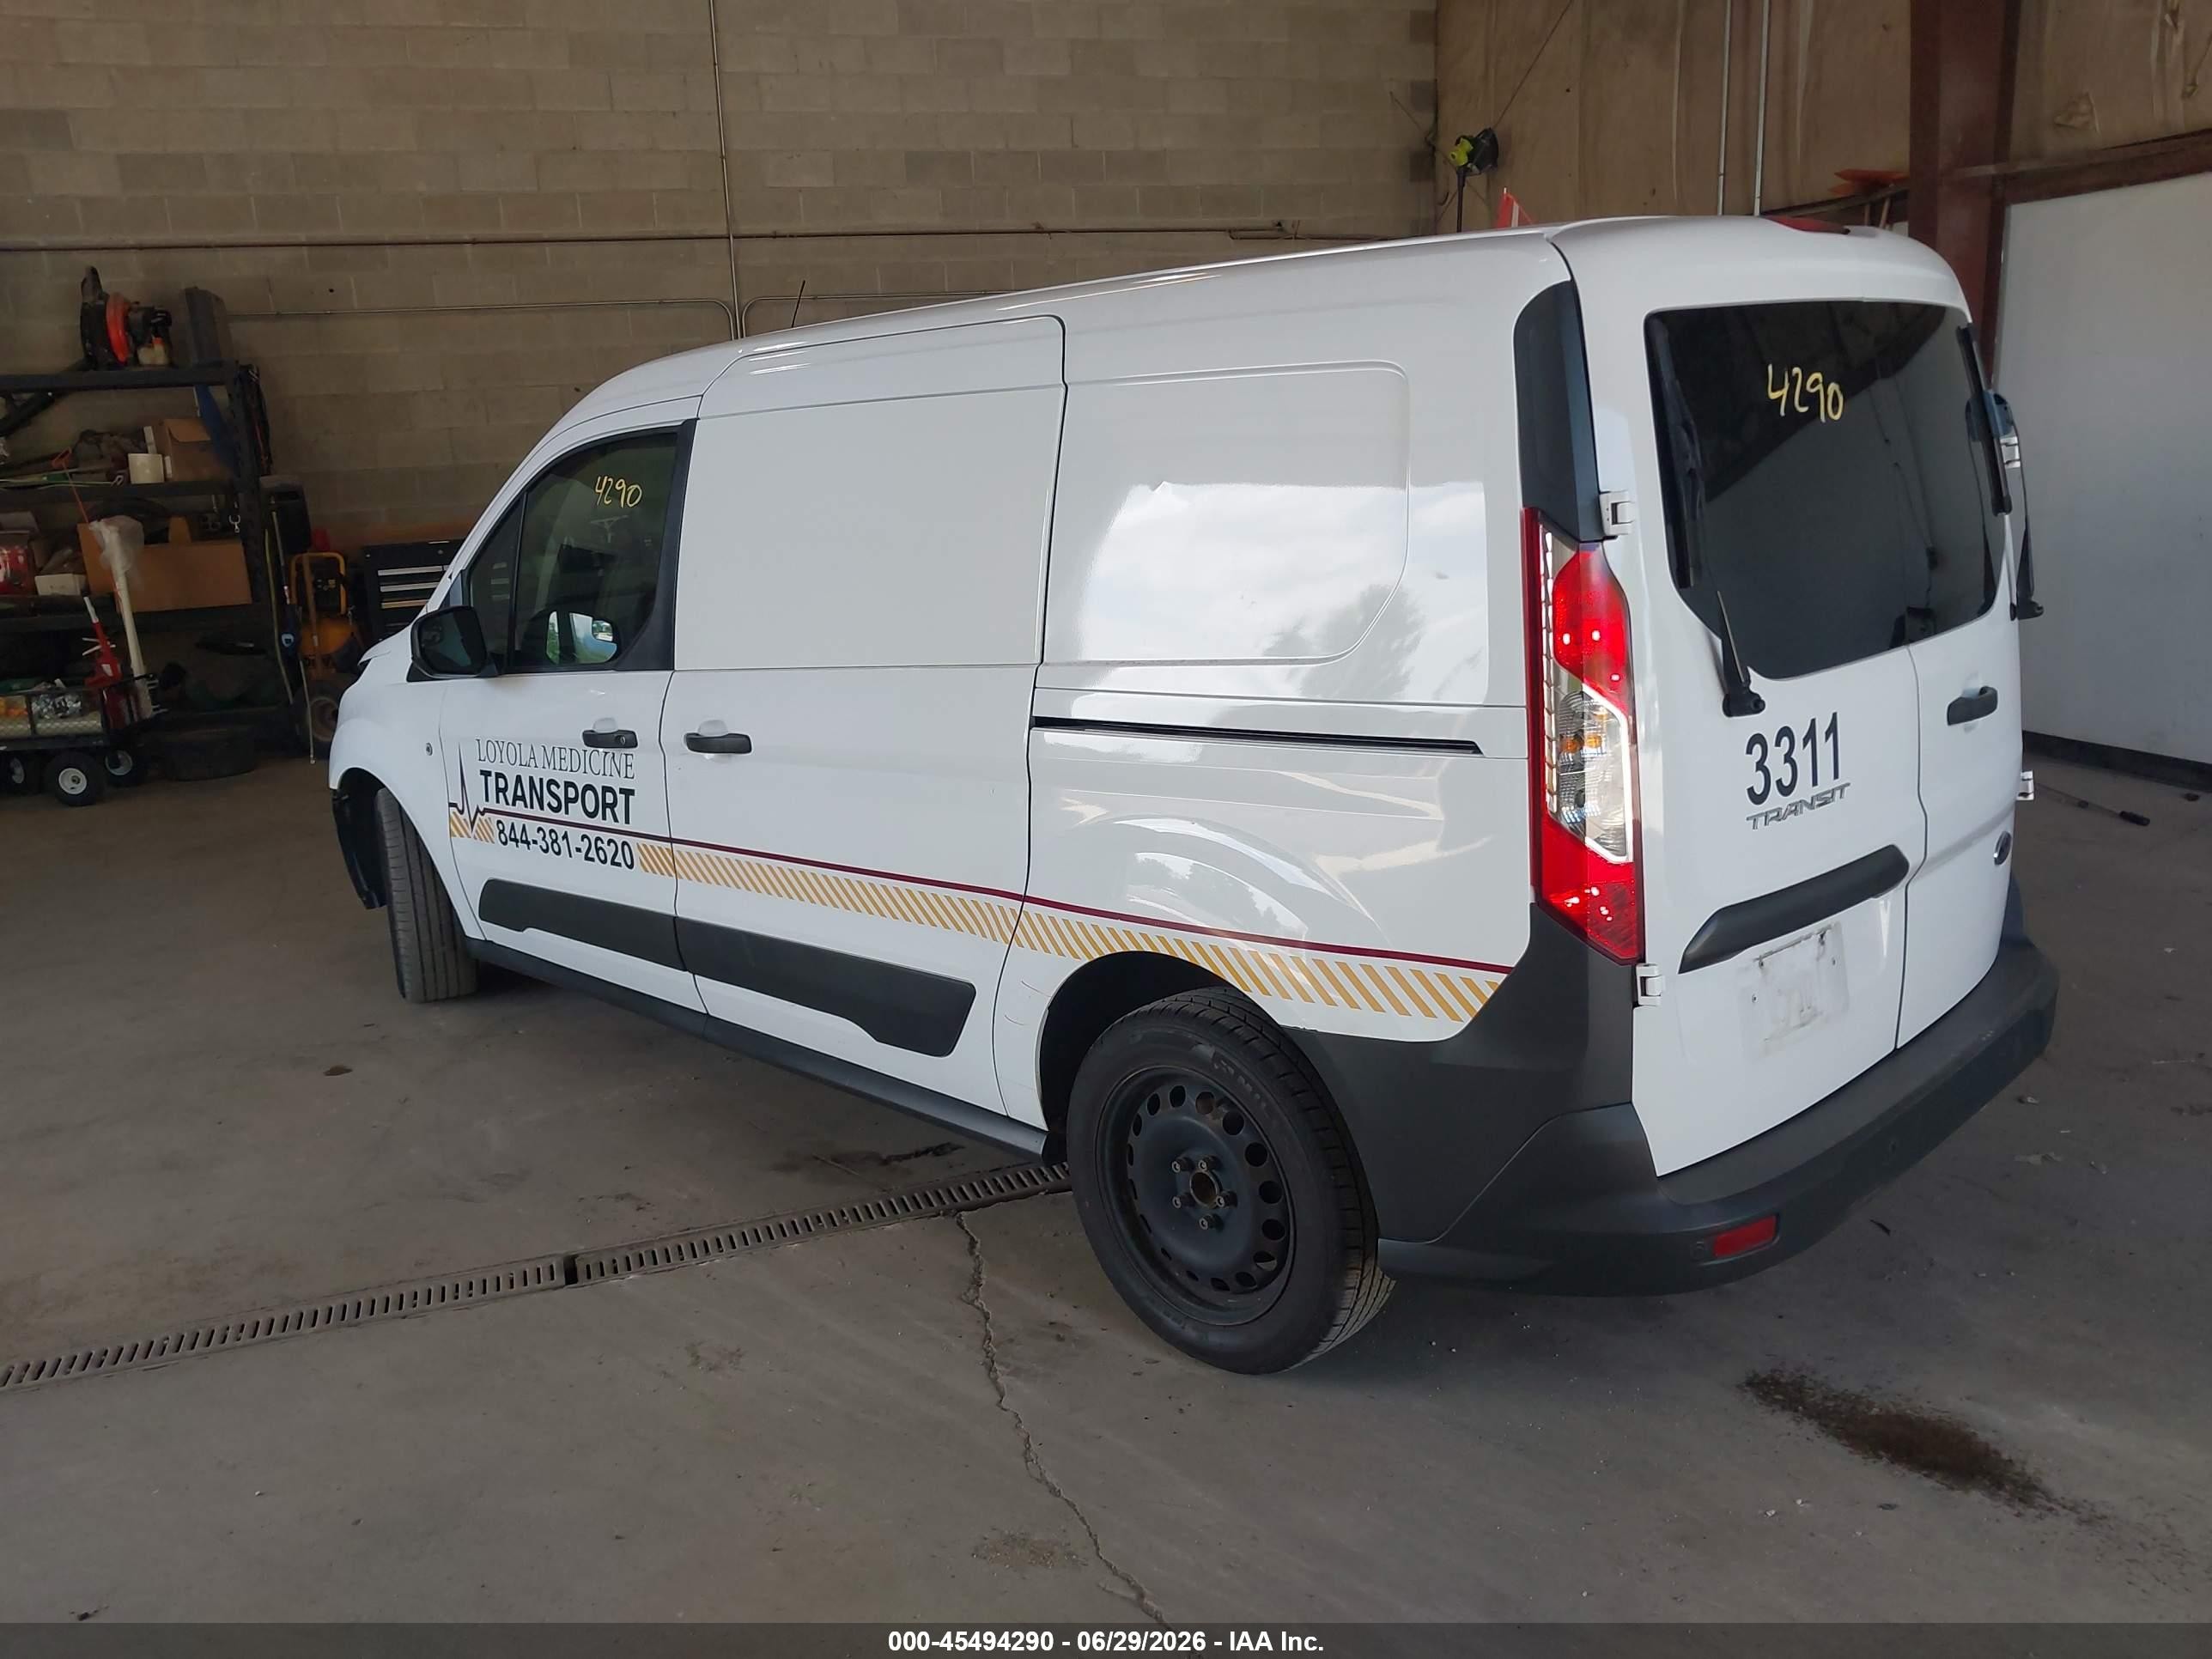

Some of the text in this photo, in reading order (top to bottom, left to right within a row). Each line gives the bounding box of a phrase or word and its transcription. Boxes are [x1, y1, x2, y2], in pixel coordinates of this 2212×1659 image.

[1767, 363, 1844, 422] 4290
[595, 476, 642, 508] 4290
[476, 738, 635, 780] LOYOLA MEDICINE
[1746, 712, 1839, 805] 3311
[479, 769, 635, 825] TRANSPORT
[1746, 782, 1850, 830] TRANSIT
[495, 819, 635, 871] 844-381-2620
